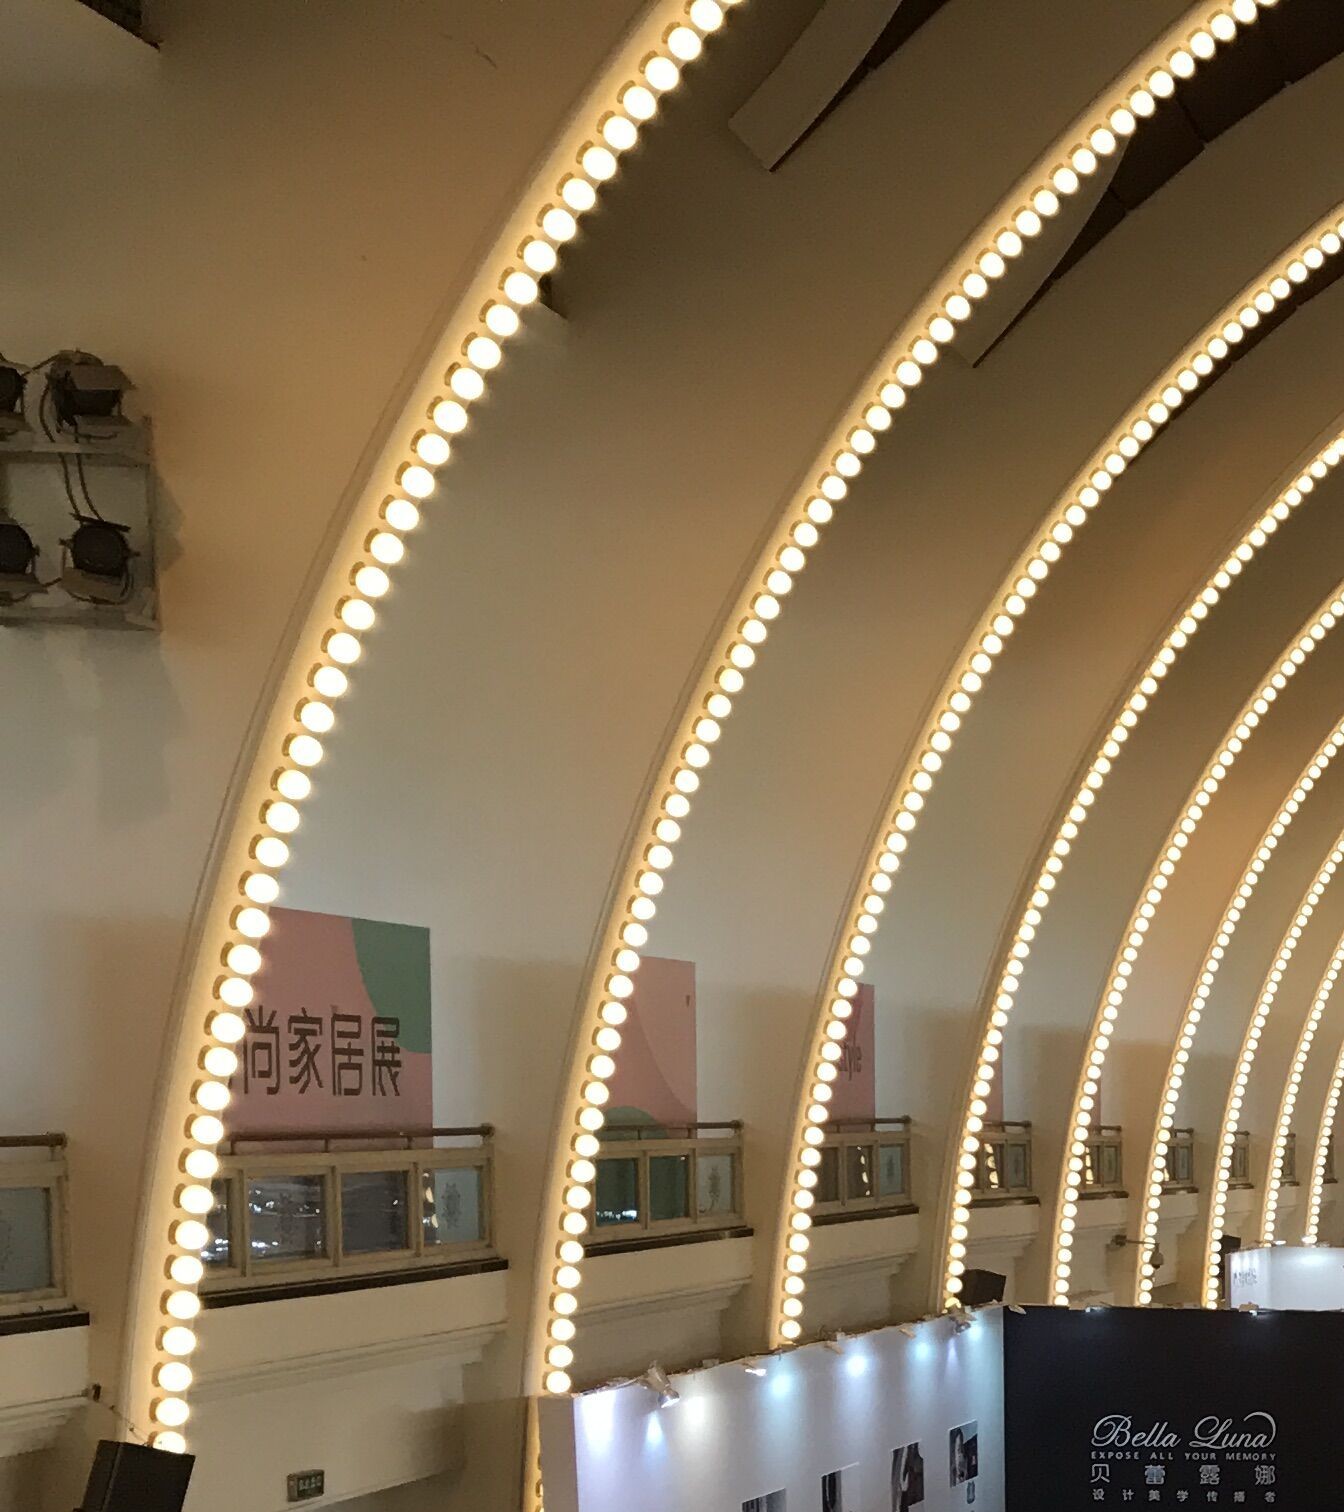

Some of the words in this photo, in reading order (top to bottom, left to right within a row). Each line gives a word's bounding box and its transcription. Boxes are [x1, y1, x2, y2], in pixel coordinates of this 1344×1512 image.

[236, 1005, 402, 1096] 尚家居展
[1091, 1414, 1181, 1448] Bella
[1189, 1411, 1277, 1450] Luna
[1091, 1451, 1140, 1461] EXPOSE
[1150, 1451, 1174, 1461] ALL
[1184, 1451, 1217, 1461] YOUR
[1225, 1452, 1277, 1462] MEMORY
